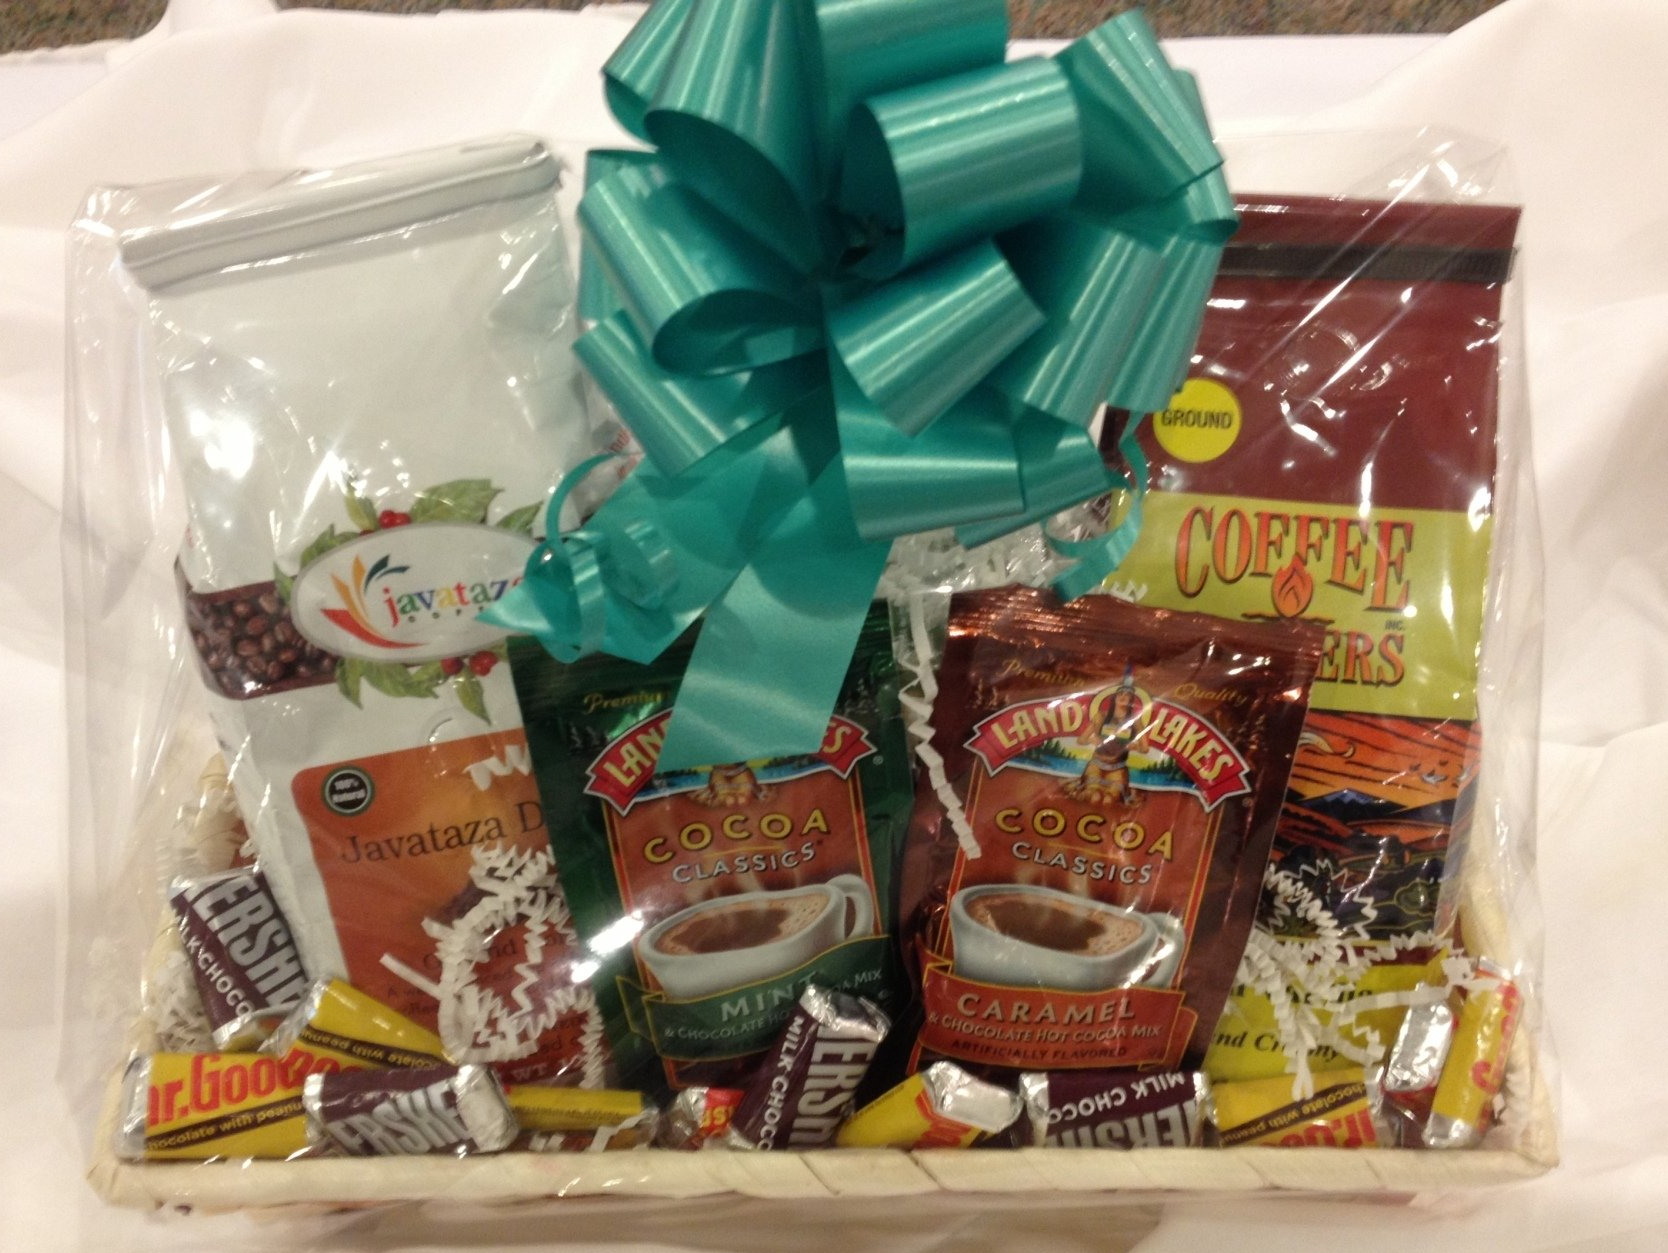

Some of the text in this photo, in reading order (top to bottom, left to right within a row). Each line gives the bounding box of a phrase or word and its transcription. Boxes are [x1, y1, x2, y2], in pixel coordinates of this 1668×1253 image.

[1161, 408, 1232, 429] GROUND
[1174, 503, 1415, 614] COFFEE
[382, 575, 524, 628] javataz
[1001, 658, 1249, 706] Premium Quality
[991, 696, 1085, 749] LAND
[1149, 707, 1234, 781] LAKES
[341, 815, 508, 865] Javataza
[645, 809, 829, 864] COCOA
[995, 808, 1174, 862] COCOA
[672, 841, 817, 883] CLASSICS
[1012, 840, 1154, 884] CLASSICS
[678, 1016, 765, 1041] CHOCOLATE
[941, 1016, 1033, 1042] CHOCOLATE
[1035, 1029, 1067, 1043] HOT
[1072, 1025, 1128, 1044] COCOA
[1131, 1023, 1161, 1038] MIX
[956, 992, 1136, 1026] CARAMEL
[776, 1016, 805, 1073] MILK
[951, 1039, 1128, 1059] ARTIFICIALLY FLAVORED
[1130, 1072, 1185, 1099] MILK
[219, 1113, 253, 1133] with
